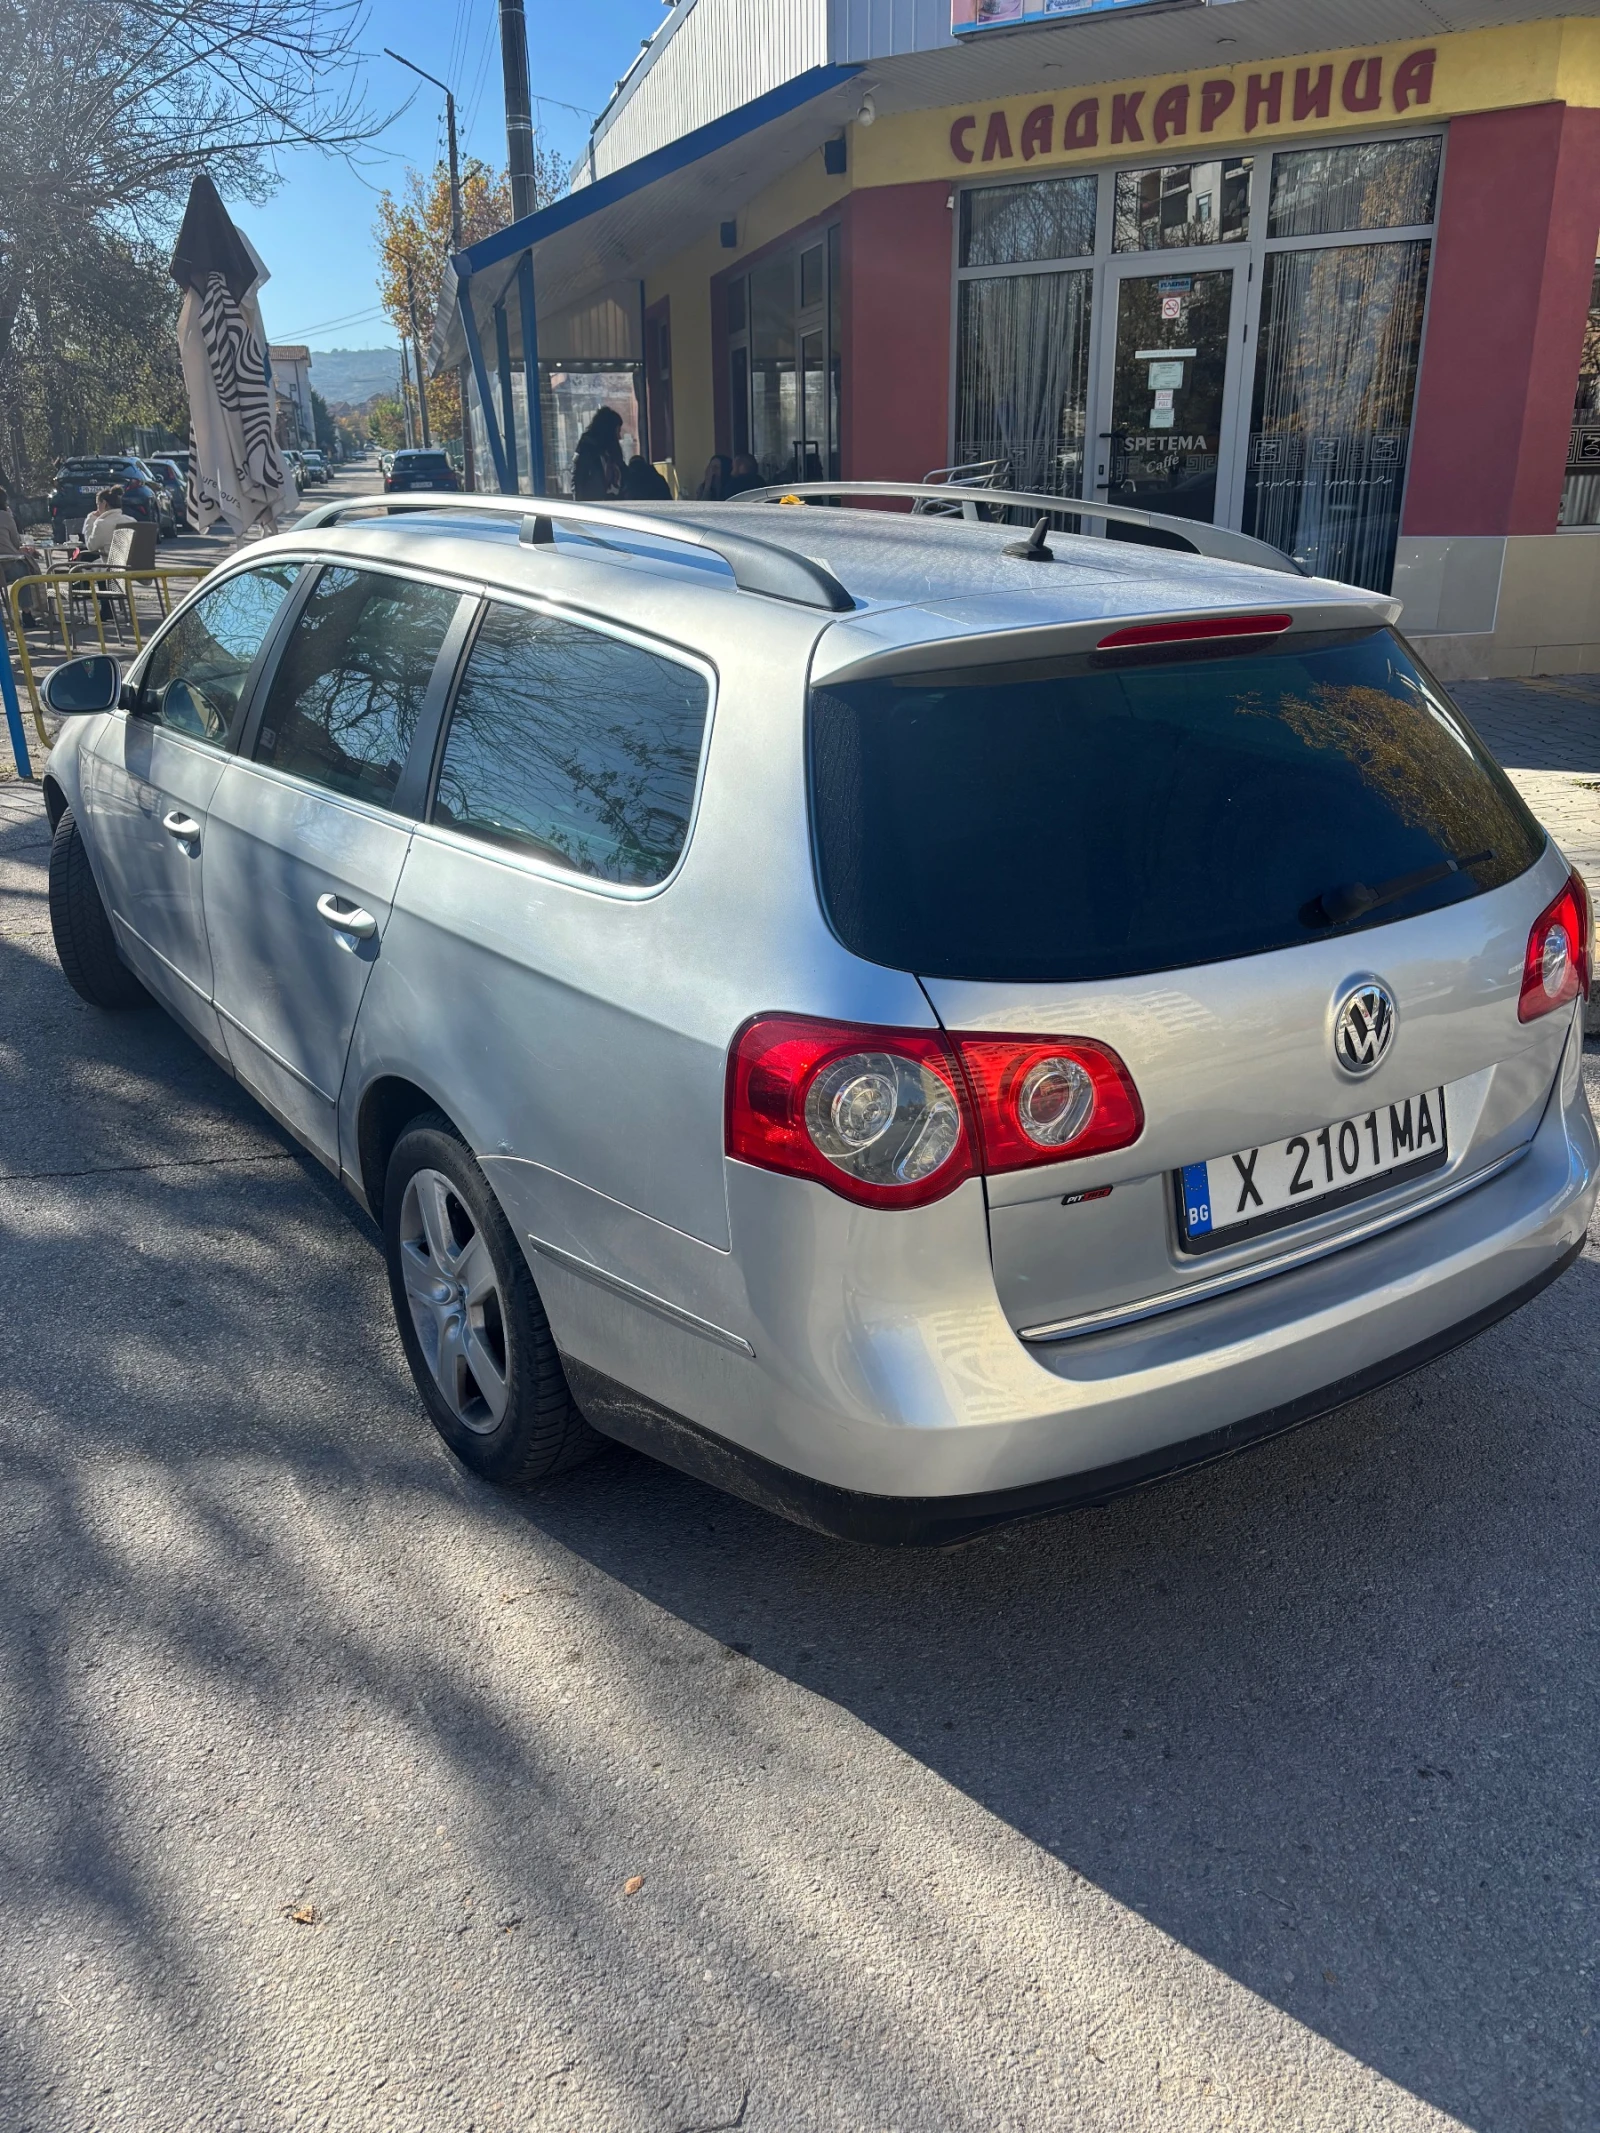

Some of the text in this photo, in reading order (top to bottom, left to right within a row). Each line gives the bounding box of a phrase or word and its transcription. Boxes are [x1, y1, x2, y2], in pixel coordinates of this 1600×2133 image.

[949, 48, 1437, 163] СЛАДКАРНИЦА
[1124, 435, 1208, 451] SPETEMA
[1285, 1111, 1380, 1195] 2101
[1188, 1204, 1209, 1225] BG
